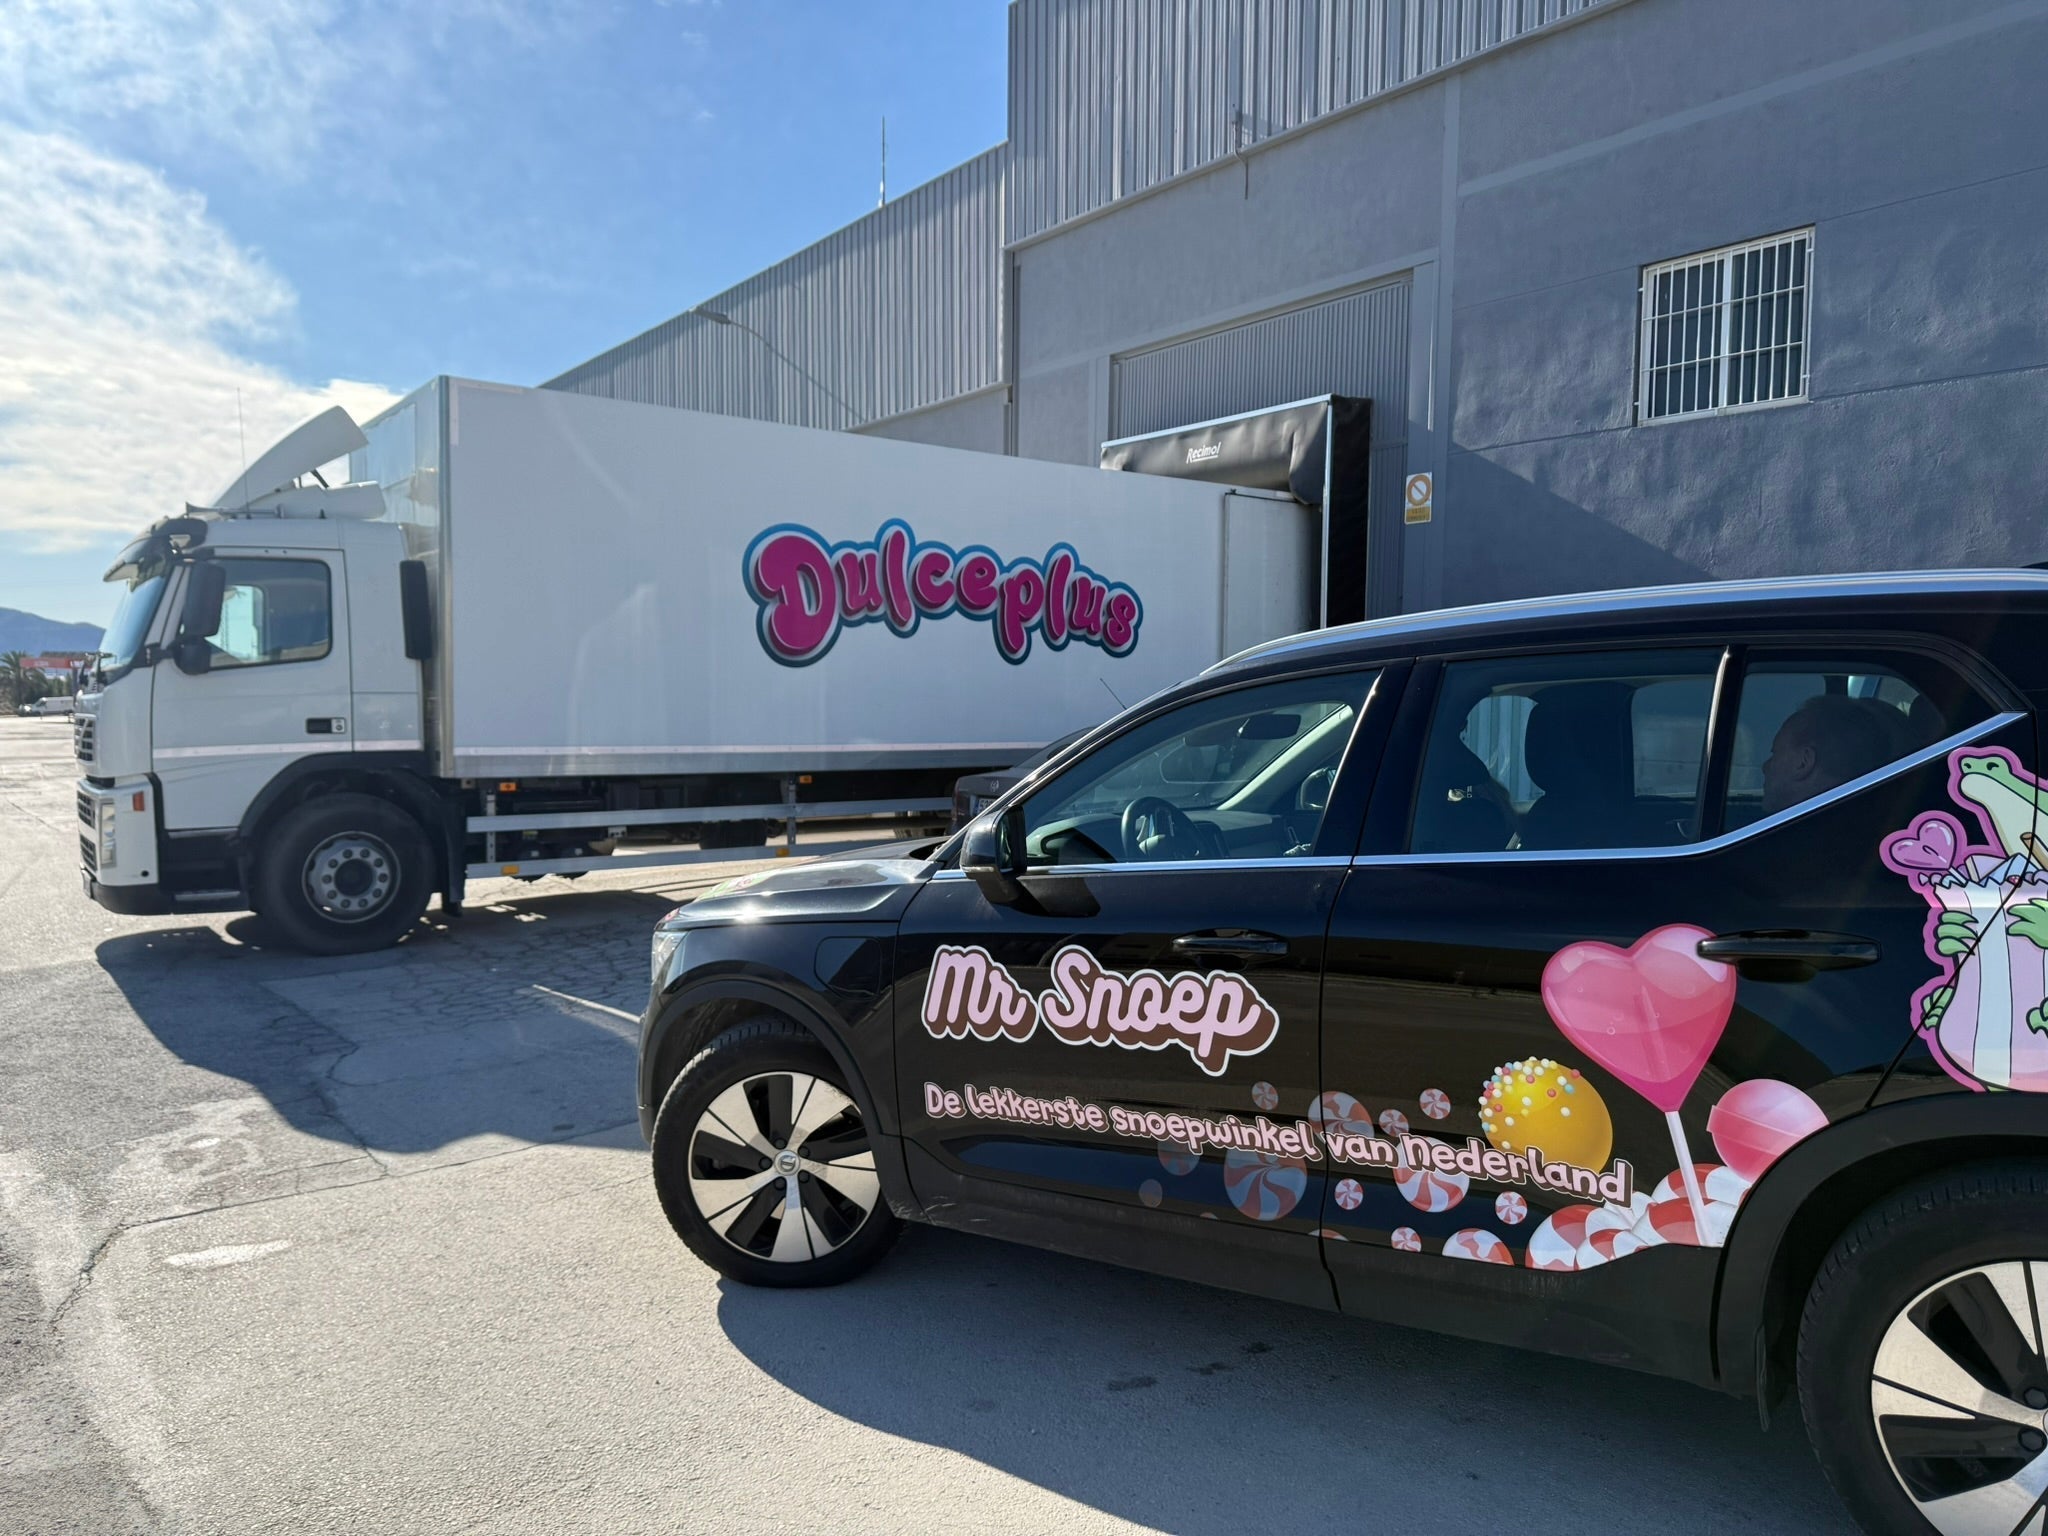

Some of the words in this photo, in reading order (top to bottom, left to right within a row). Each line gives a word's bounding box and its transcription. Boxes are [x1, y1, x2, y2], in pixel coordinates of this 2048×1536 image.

[746, 521, 1140, 663] Dulceplus
[923, 946, 1036, 1038] Mr
[1041, 945, 1274, 1070] Snoep
[925, 1083, 965, 1116] De
[966, 1085, 1107, 1130] lekkerste
[1110, 1106, 1320, 1159] snoepwinkel
[1325, 1132, 1396, 1165] van
